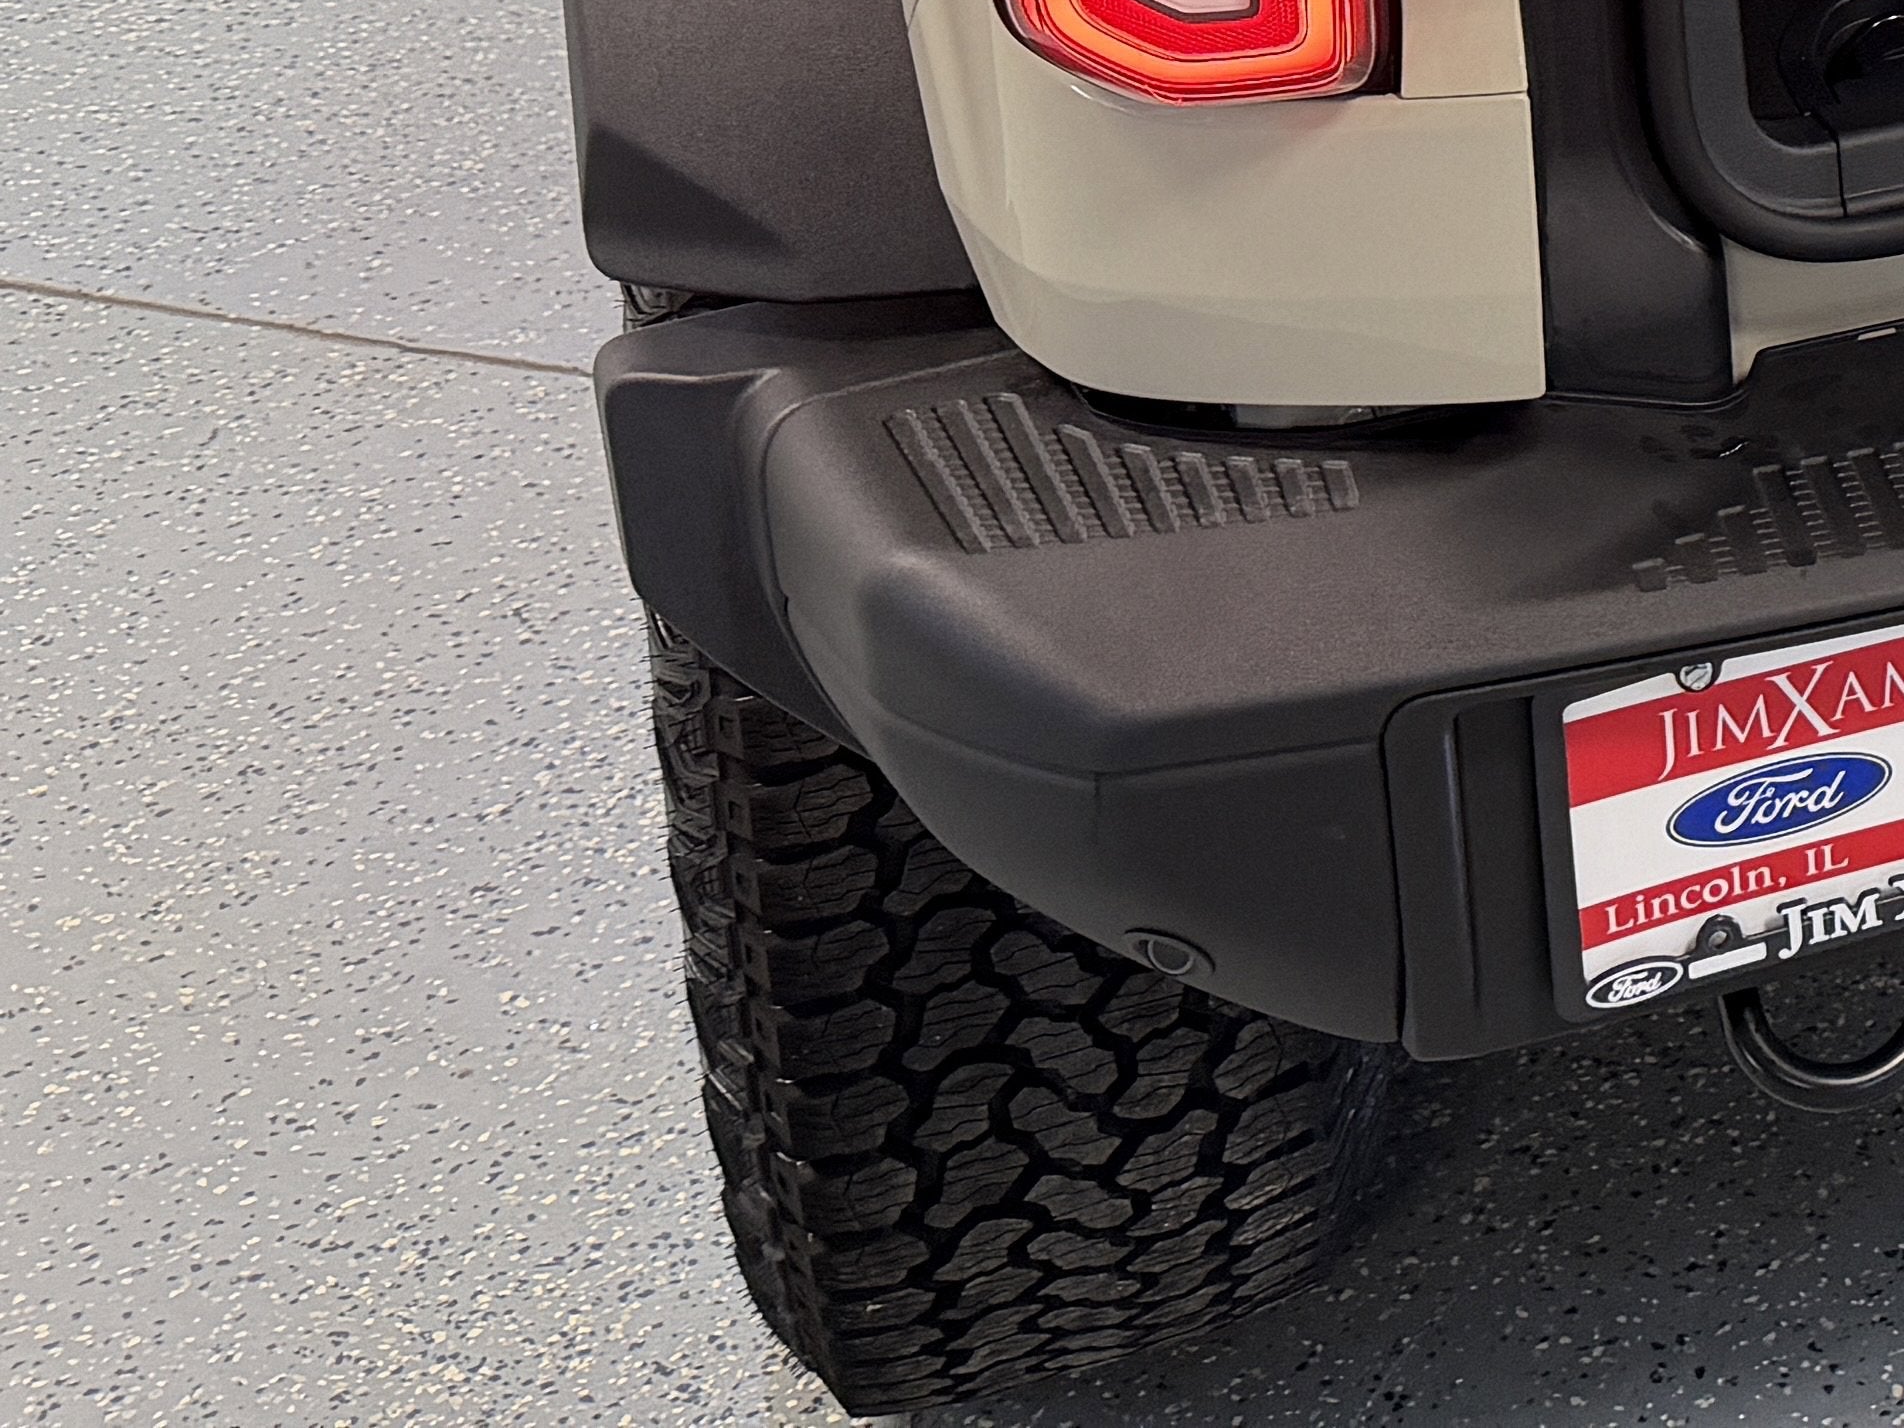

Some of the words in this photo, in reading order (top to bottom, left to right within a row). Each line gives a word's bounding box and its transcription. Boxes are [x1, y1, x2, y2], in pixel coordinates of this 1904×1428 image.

[1713, 768, 1847, 835] Ford
[1605, 864, 1787, 935] Lincoln,
[1804, 844, 1848, 876] IL
[1607, 971, 1663, 1003] Ford
